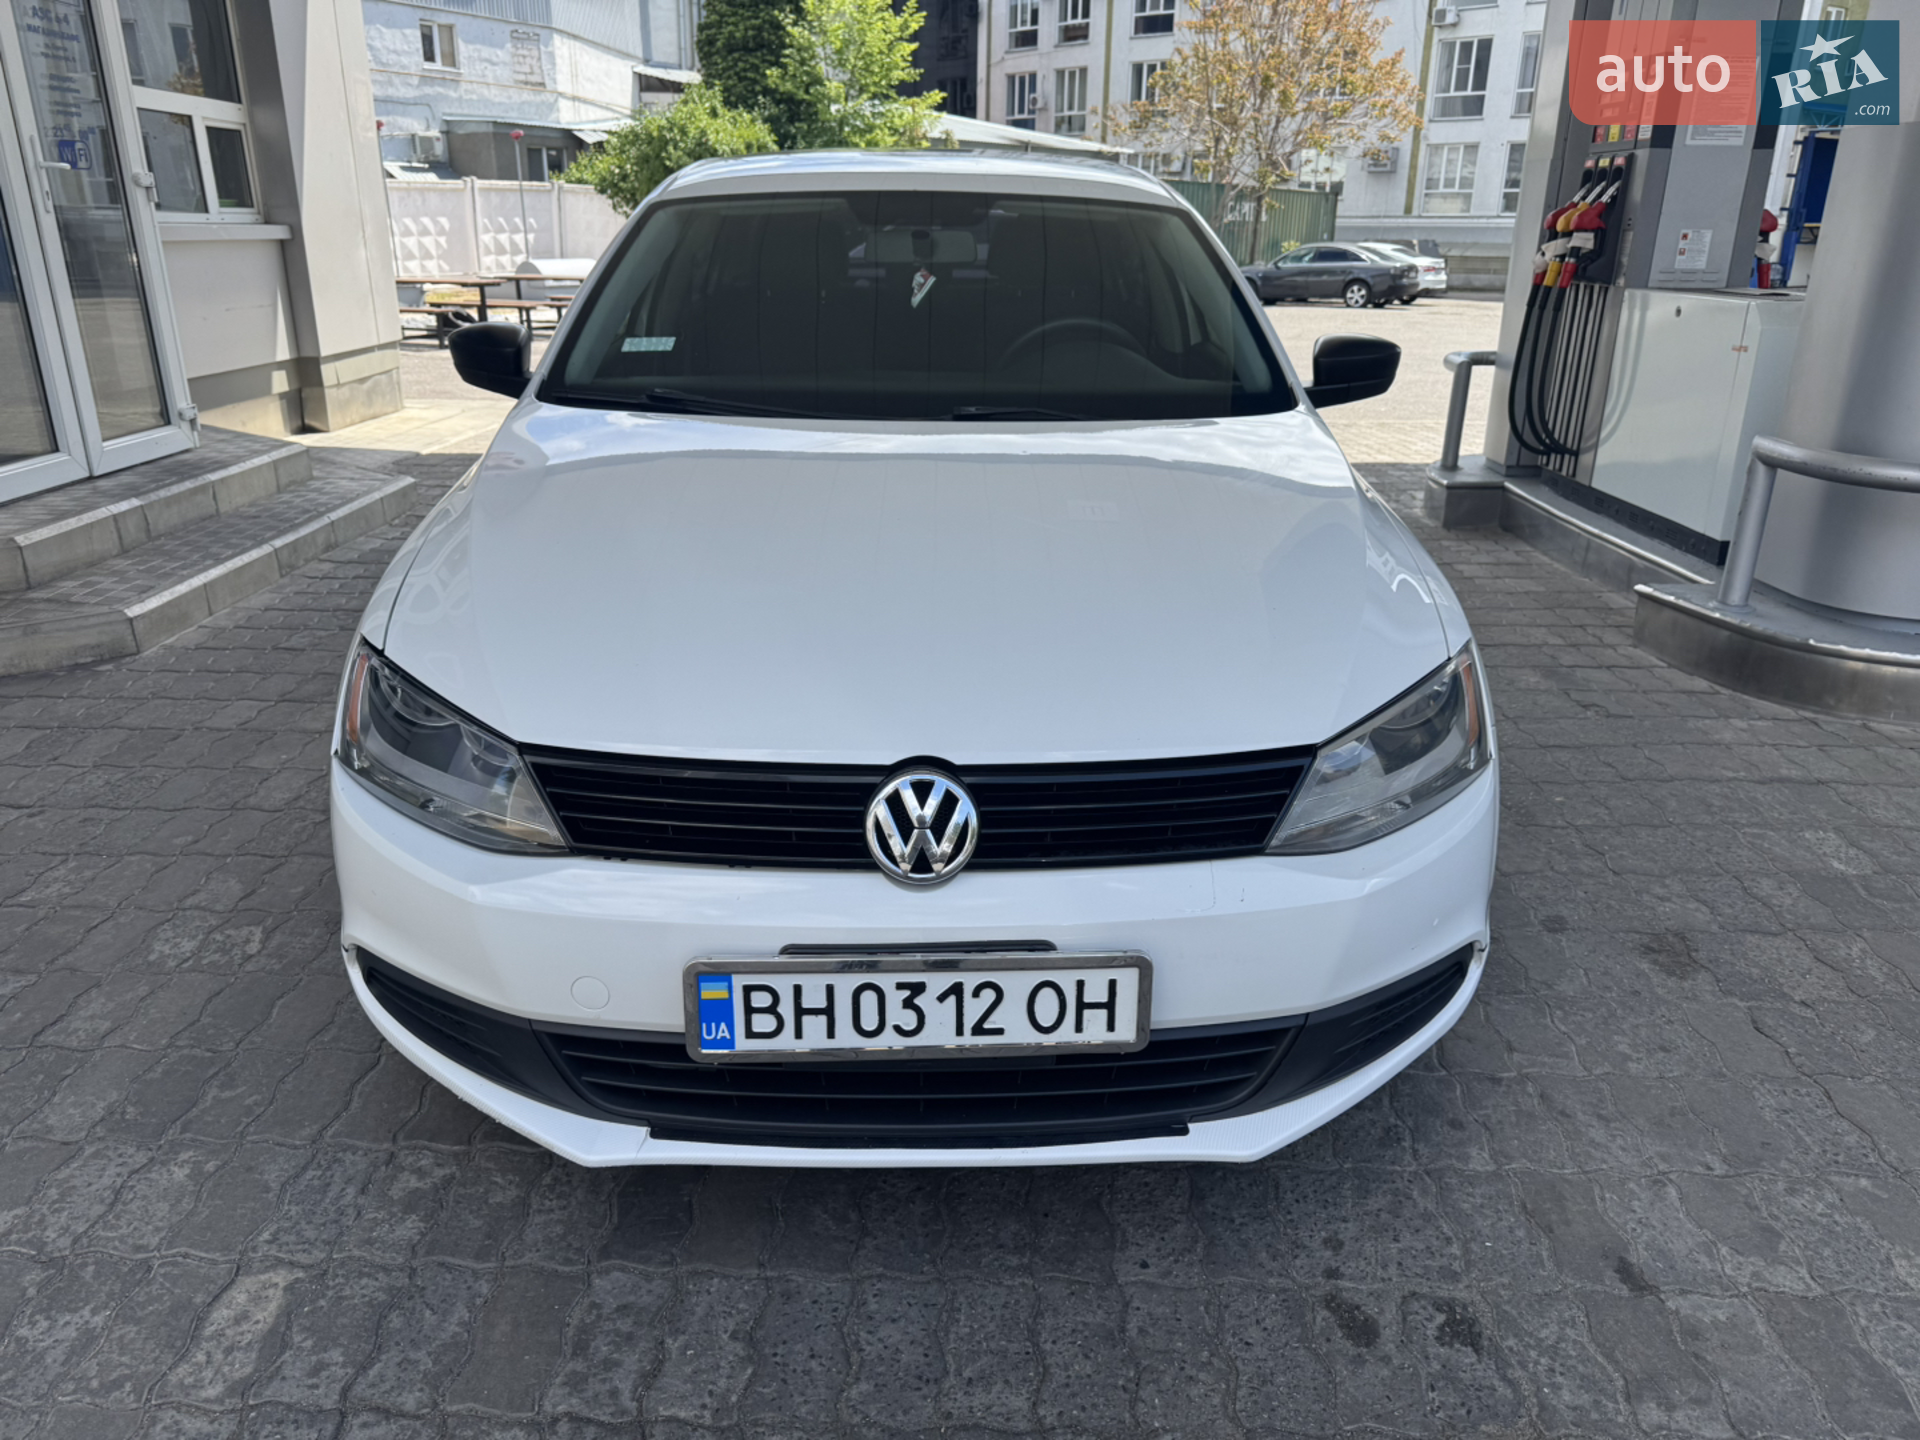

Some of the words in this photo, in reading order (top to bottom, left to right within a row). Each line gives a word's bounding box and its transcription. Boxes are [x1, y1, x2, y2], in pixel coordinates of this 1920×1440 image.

[1227, 201, 1268, 222] CAPITL
[1026, 978, 1118, 1035] OH
[702, 1021, 732, 1041] UA
